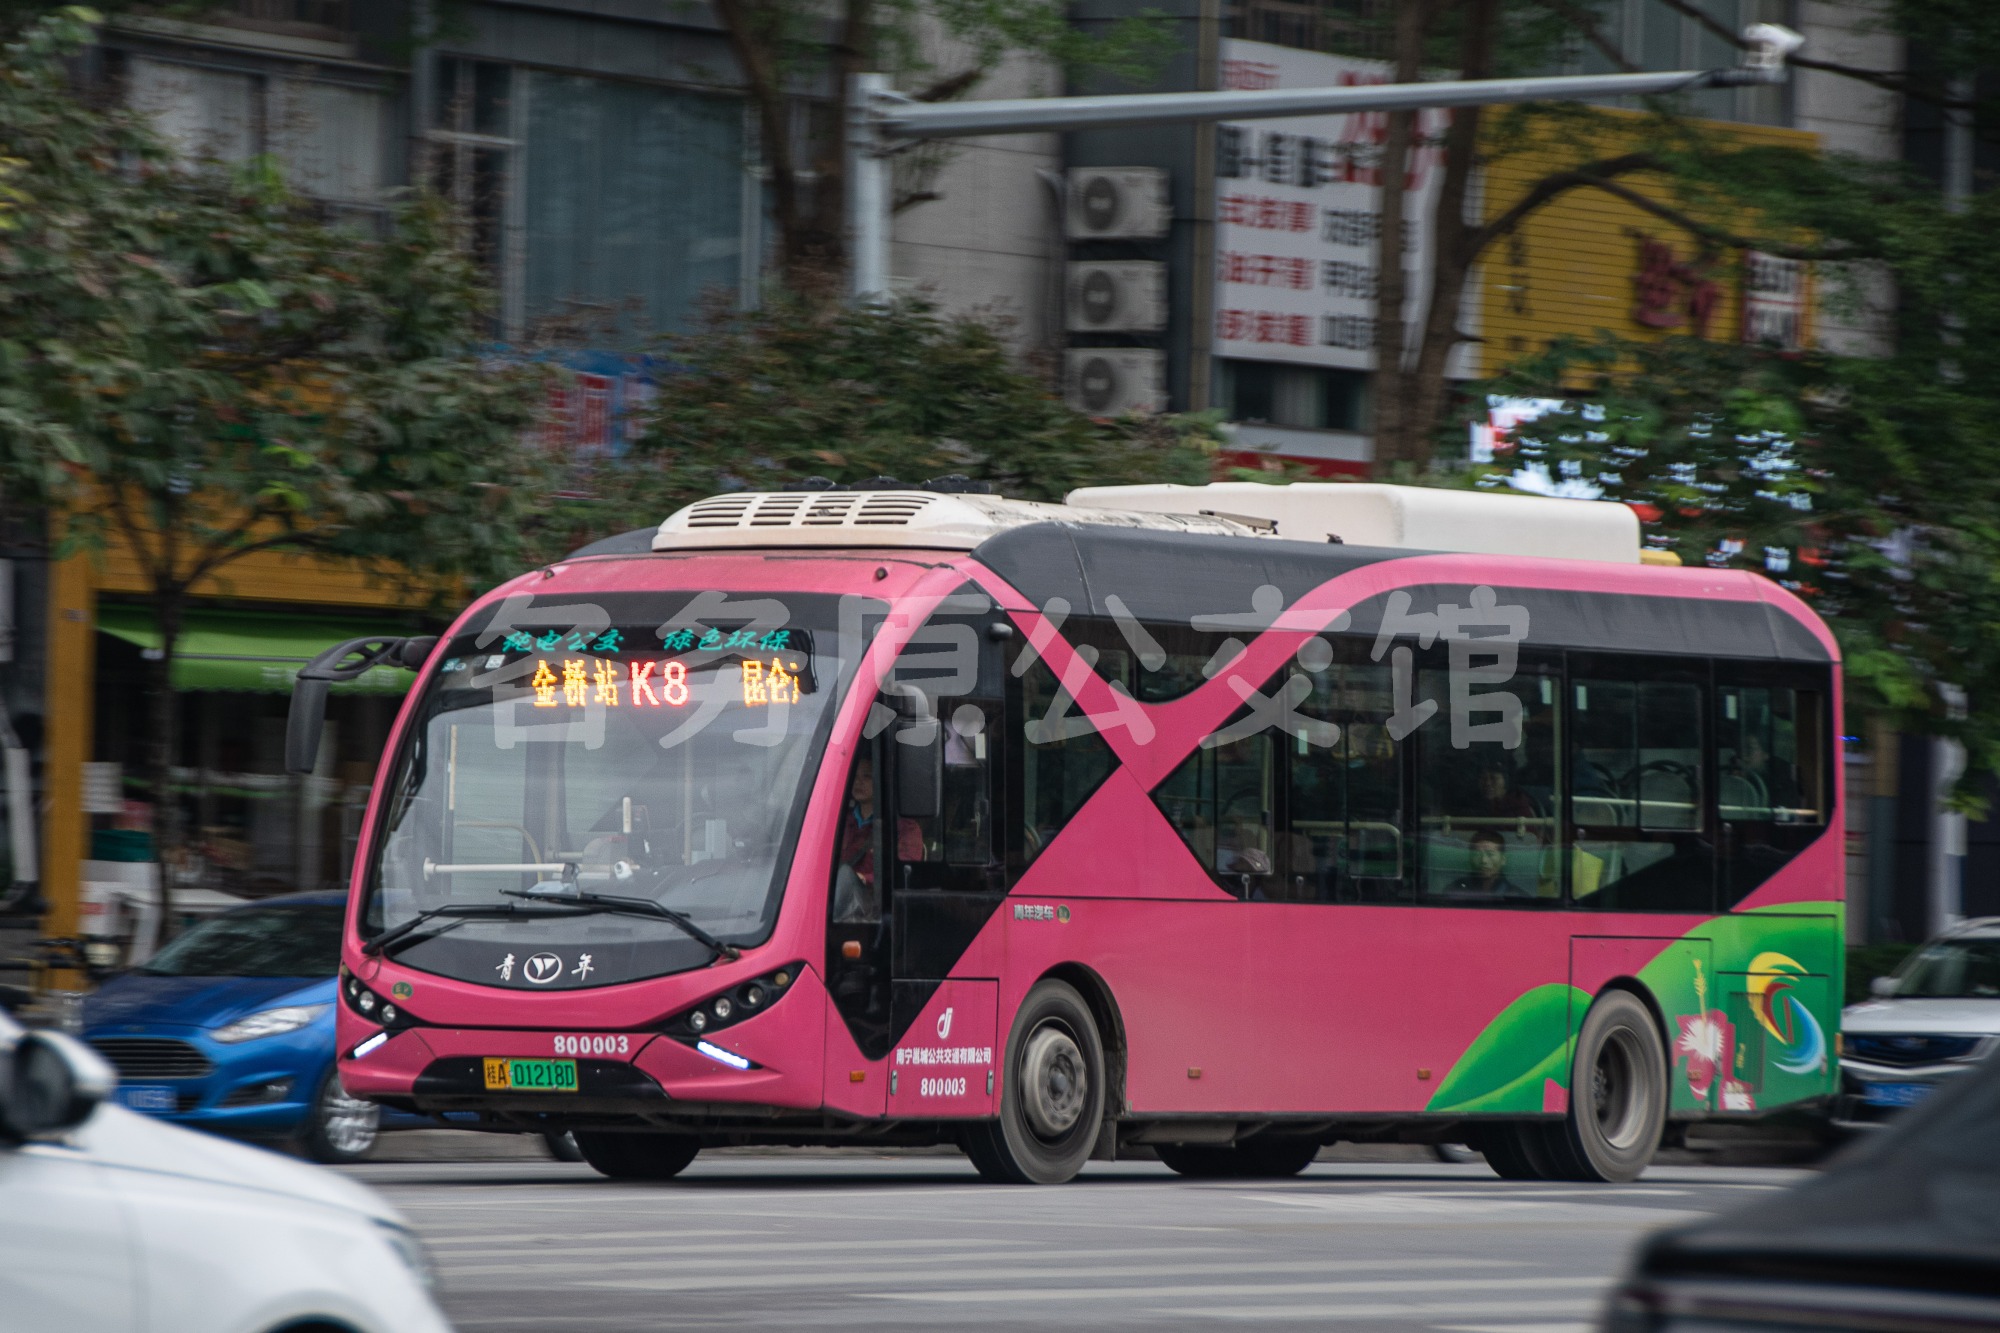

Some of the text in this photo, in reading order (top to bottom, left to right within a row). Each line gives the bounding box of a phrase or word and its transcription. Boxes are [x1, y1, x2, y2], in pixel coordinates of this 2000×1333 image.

[502, 627, 791, 653] 纯电公交 绿色环保
[532, 659, 619, 707] 金桥站
[630, 660, 690, 707] K8
[553, 1035, 630, 1055] 800003
[920, 1077, 966, 1096] 800003
